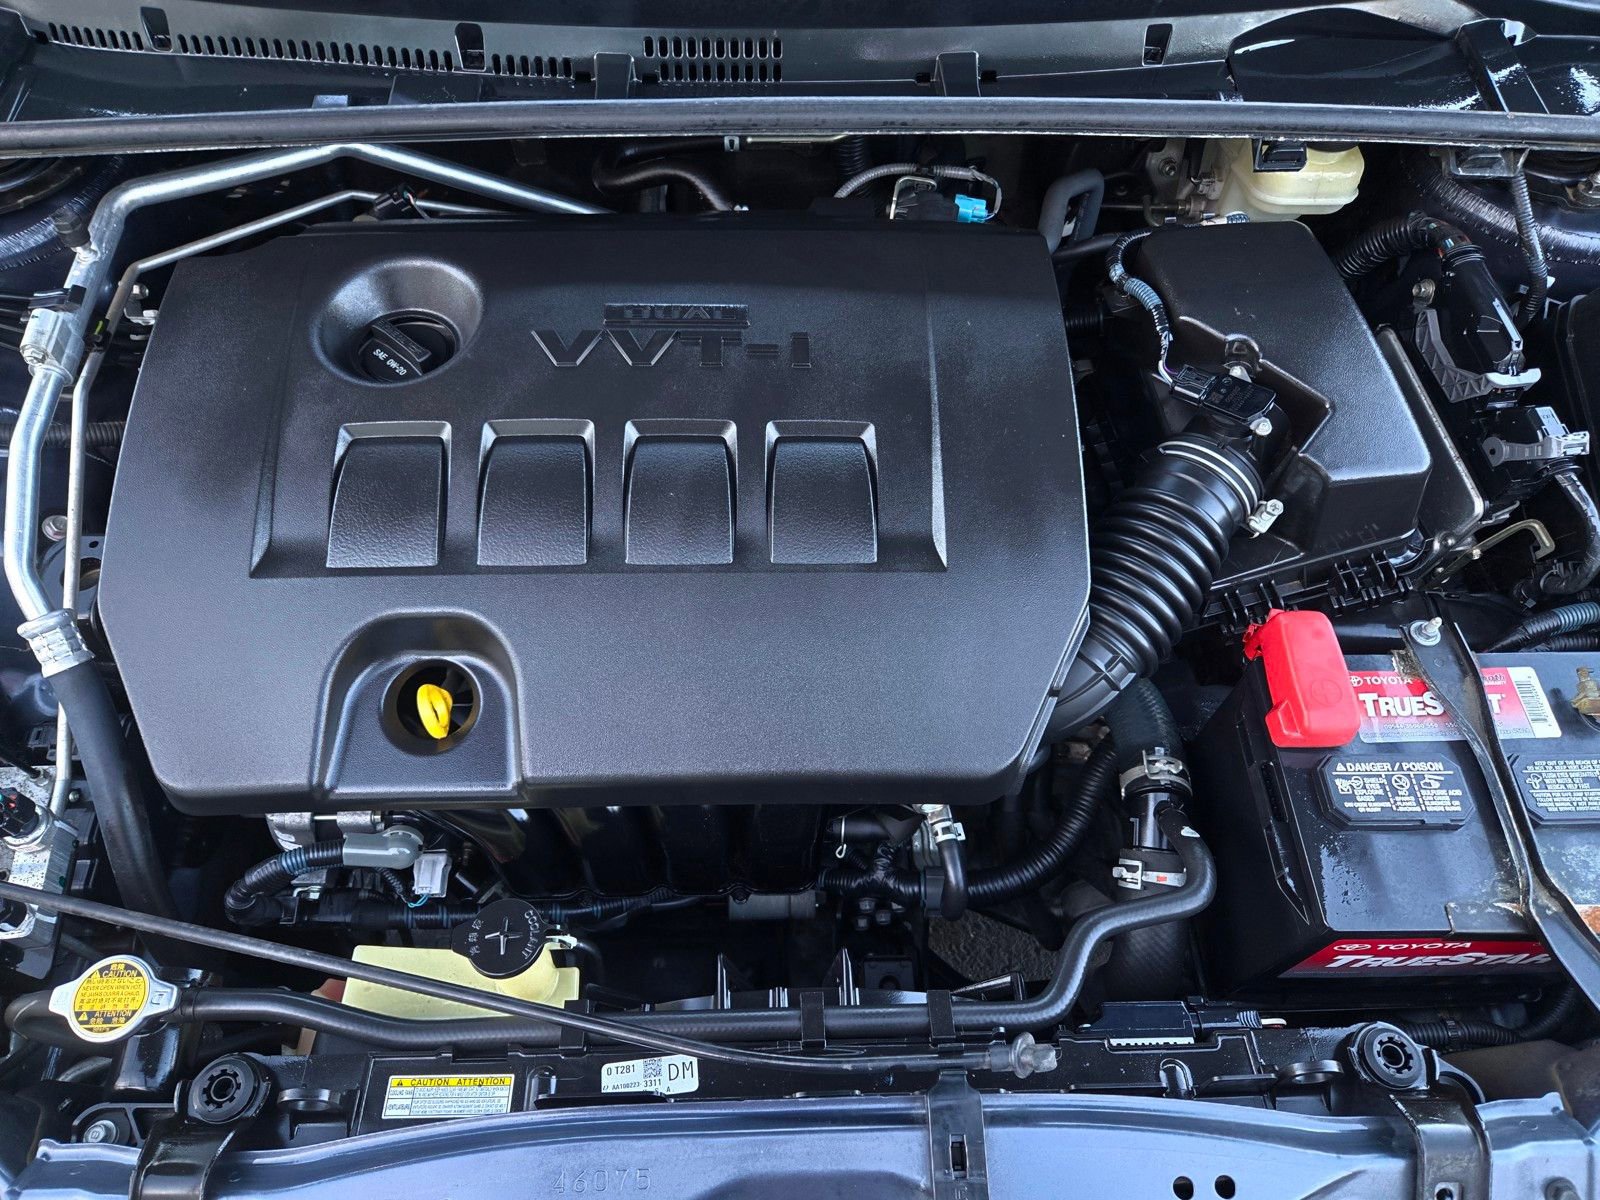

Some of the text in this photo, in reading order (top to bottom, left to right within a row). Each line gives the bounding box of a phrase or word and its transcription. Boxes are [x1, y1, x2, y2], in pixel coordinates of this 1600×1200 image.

[373, 348, 408, 376] SAE 0W-20
[1346, 762, 1392, 772] DANGER
[1401, 762, 1444, 772] POISON
[524, 909, 541, 960] COOLANT
[1376, 942, 1472, 951] TOYOTA
[102, 970, 137, 978] CAUTION
[94, 1010, 132, 1018] ATTENTION
[668, 1061, 694, 1082] DM
[410, 1077, 505, 1086] CAUTION ATTENTION
[551, 1168, 652, 1194] 46075
